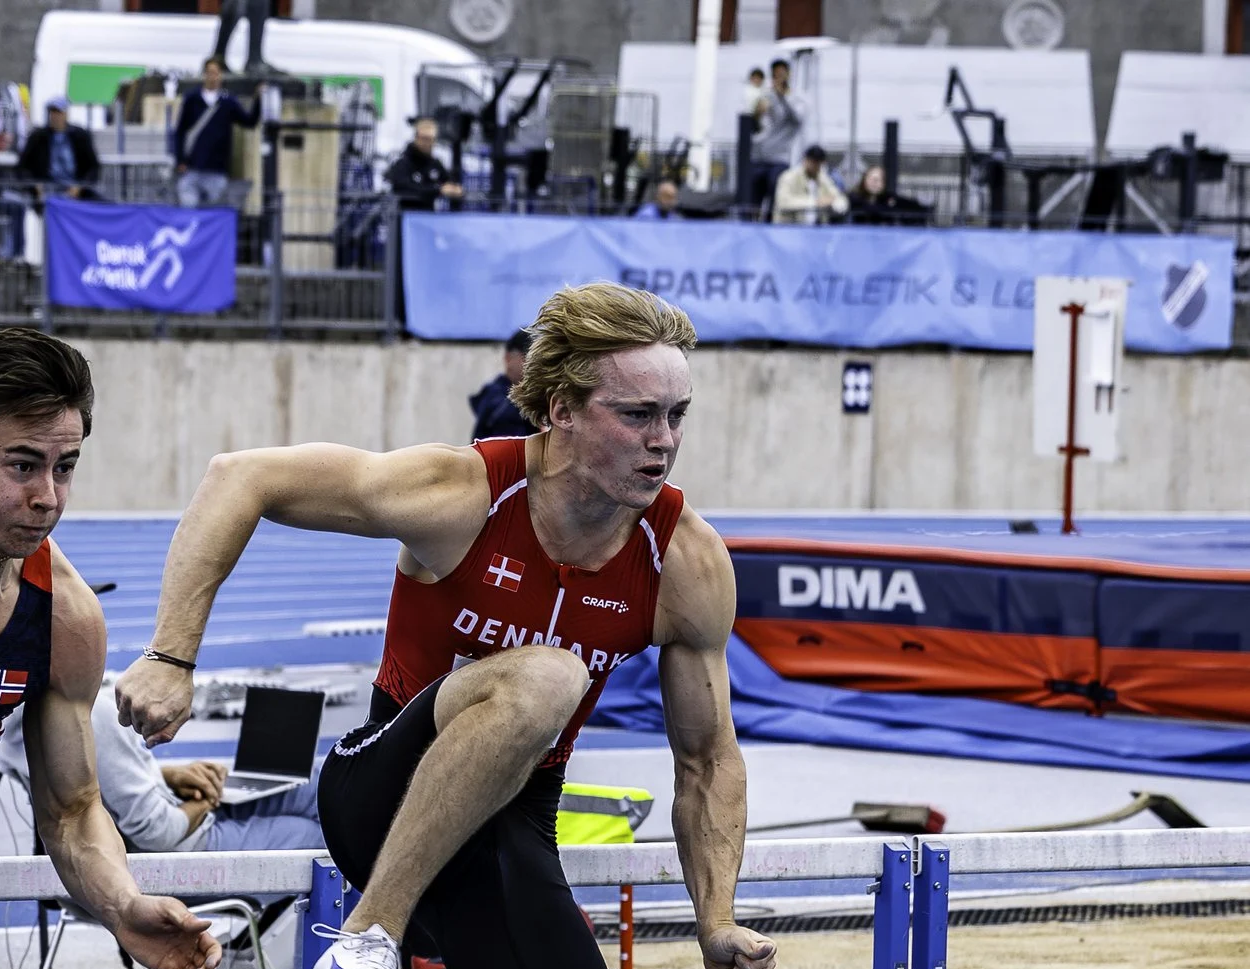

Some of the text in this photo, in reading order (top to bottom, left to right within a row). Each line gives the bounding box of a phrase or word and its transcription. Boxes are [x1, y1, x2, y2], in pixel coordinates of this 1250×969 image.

[620, 267, 780, 304] SPARTA
[792, 272, 939, 307] ATLETIK
[582, 596, 619, 611] CRAFT
[778, 564, 927, 613] DIMA
[452, 607, 630, 672] DENMARK
